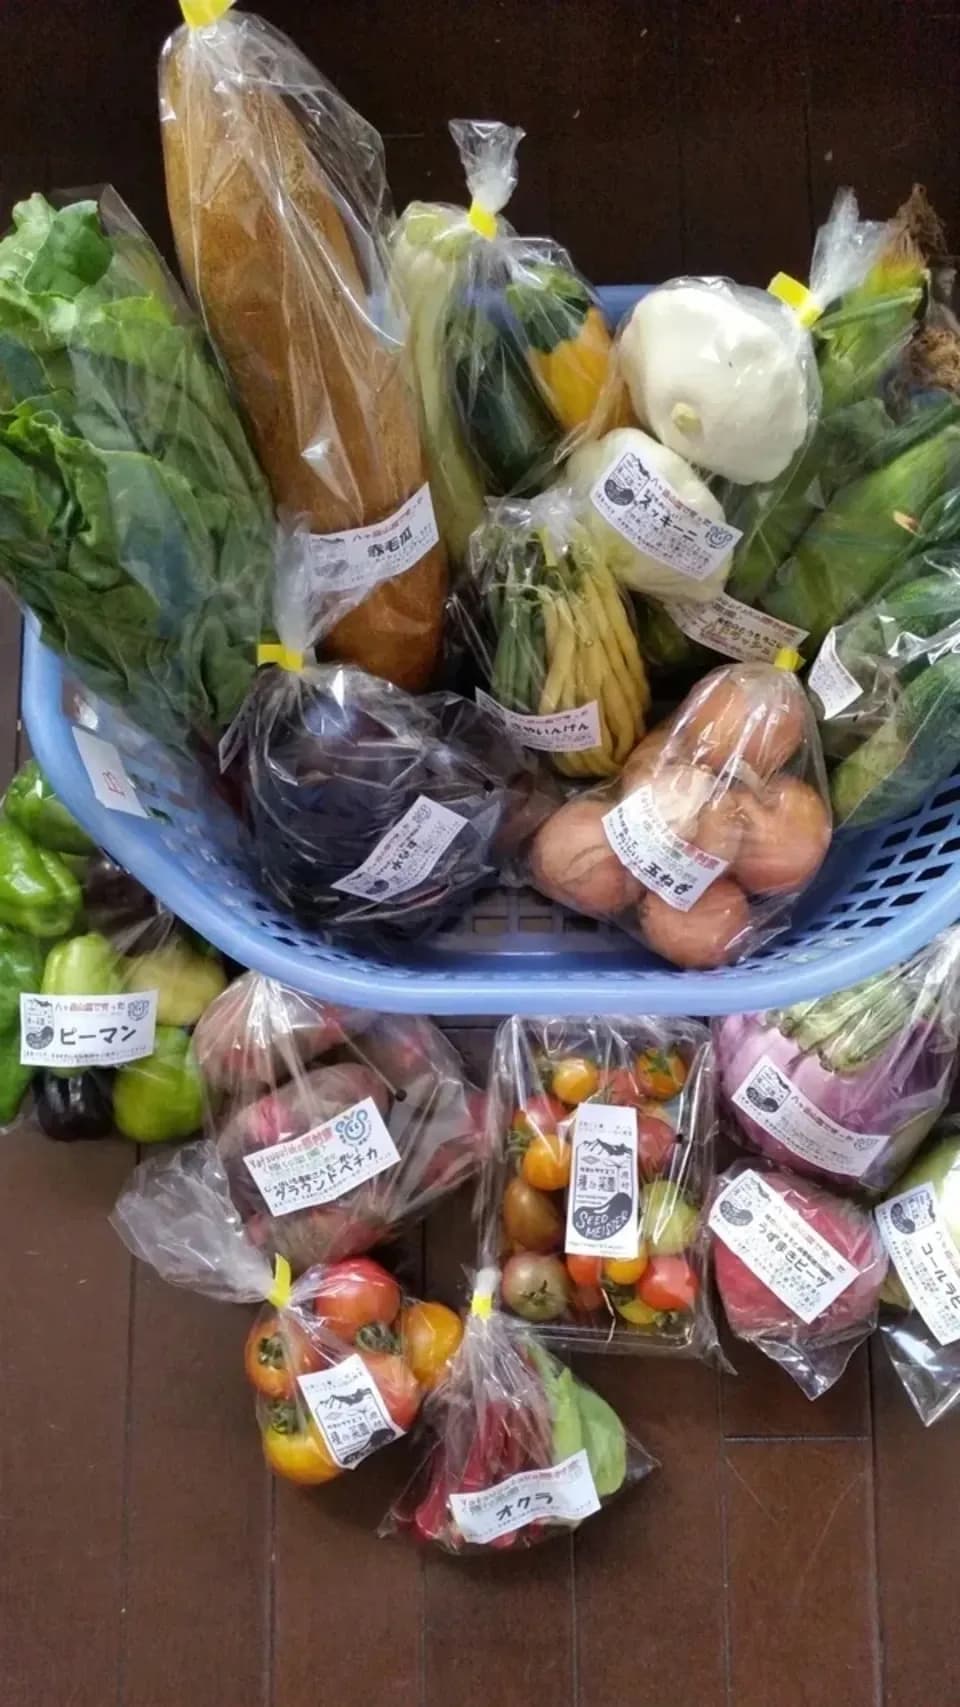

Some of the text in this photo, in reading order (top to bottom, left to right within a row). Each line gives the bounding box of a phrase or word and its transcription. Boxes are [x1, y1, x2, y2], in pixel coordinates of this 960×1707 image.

[643, 861, 693, 895] 玉ねぎ
[60, 1025, 136, 1045] ピーマン
[576, 1210, 609, 1229] SEED
[496, 1492, 553, 1521] オクラ
